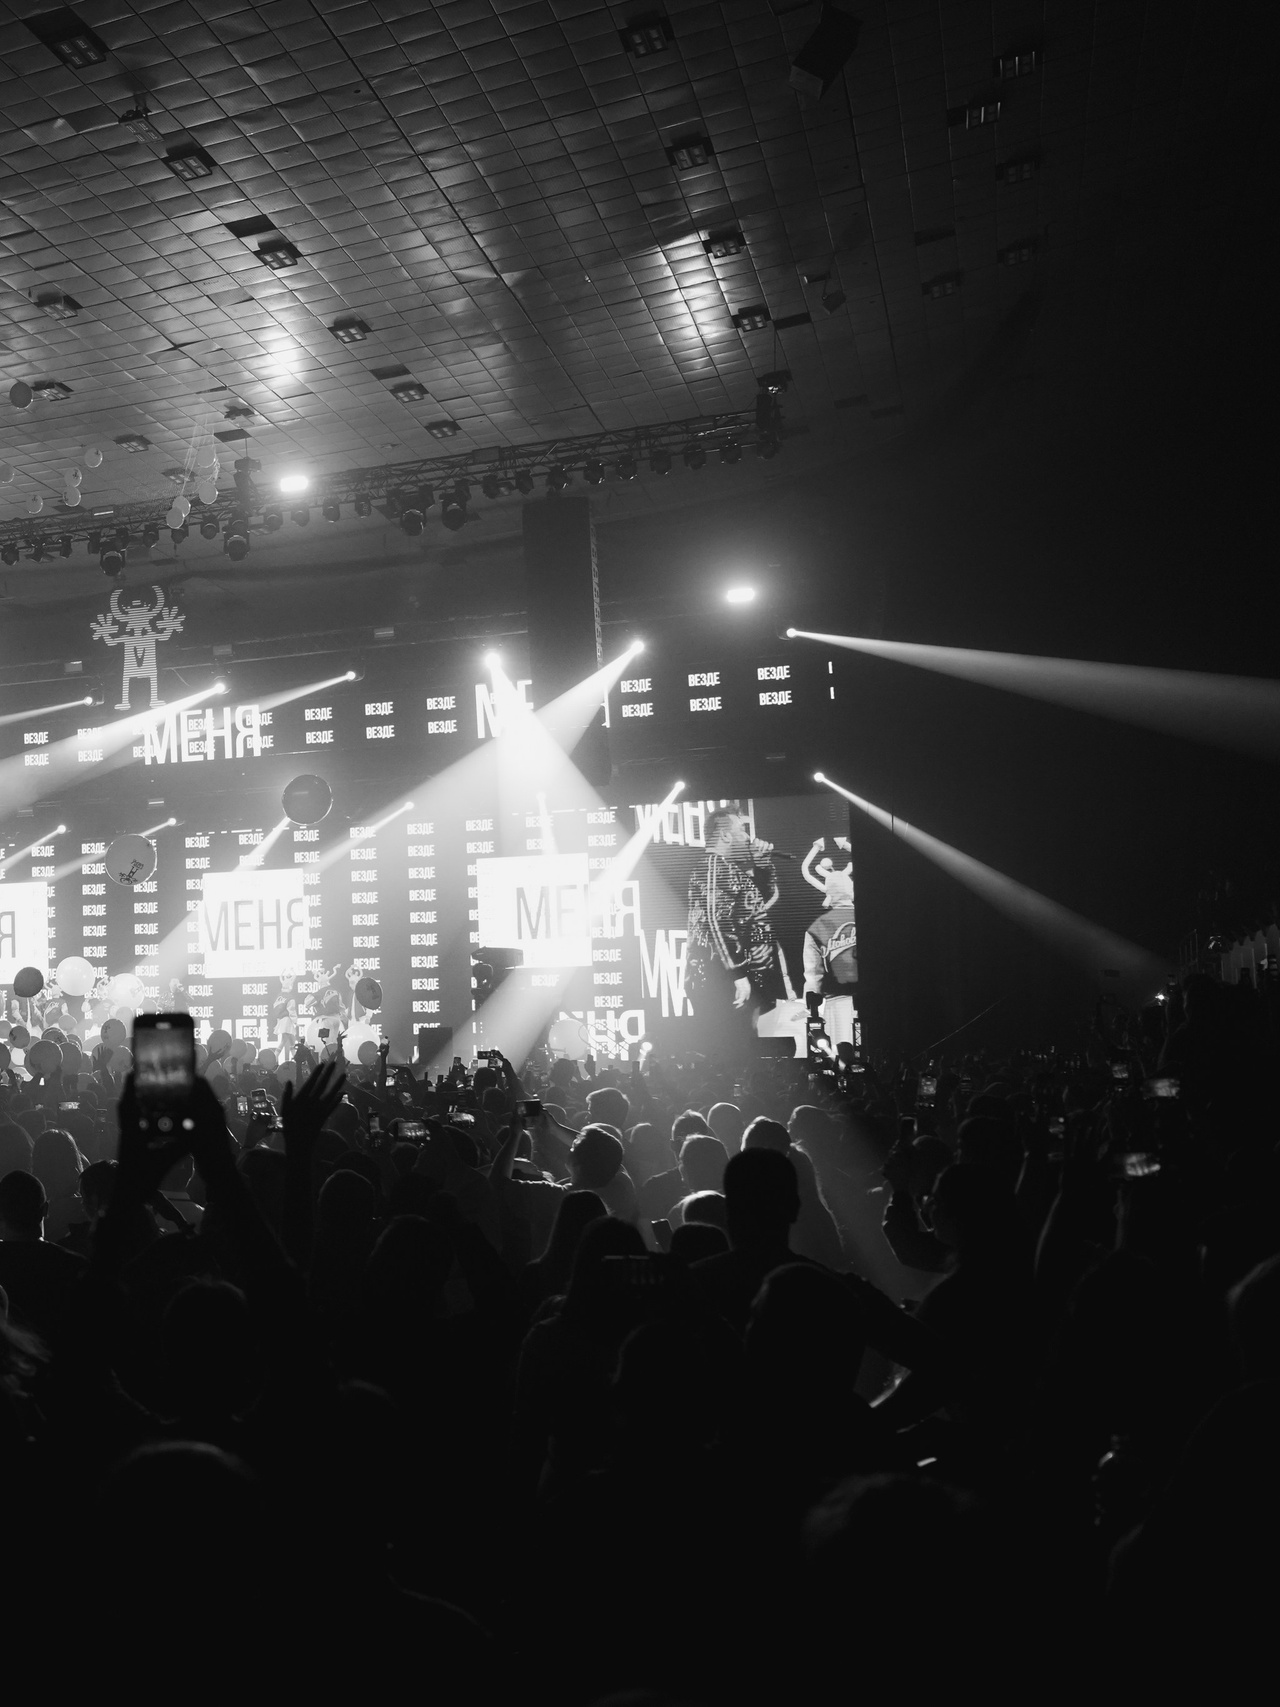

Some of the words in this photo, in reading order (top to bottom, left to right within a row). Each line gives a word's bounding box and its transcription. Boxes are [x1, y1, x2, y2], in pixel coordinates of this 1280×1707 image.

[757, 665, 790, 680] ВЕЗДЕ
[688, 672, 720, 686] ВЕЗДЕ
[621, 678, 652, 693] ВЕЗДЕ
[426, 696, 456, 710] ВЕЗДЕ
[759, 690, 792, 705] ВЕЗДЕ
[365, 702, 394, 716] ВЕЗДЕ
[622, 703, 654, 717] ВЕЗДЕ
[690, 697, 722, 711] ВЕЗДЕ
[304, 707, 333, 721] ВЕЗДЕ
[366, 725, 395, 739] ВЕЗДЕ
[428, 720, 457, 734] ВЕЗДЕ
[24, 731, 49, 744] ВЕЗДЕ
[77, 727, 103, 740] ВЕЗДЕ
[145, 705, 261, 765] МЕНЯ
[306, 730, 334, 744] ВЕЗДЕ
[25, 754, 49, 766] ВЕЗДЕ
[78, 749, 104, 762] ВЕЗДЕ
[587, 811, 616, 824] ВЕЗДЕ
[407, 823, 434, 835] ВЕЗДЕ
[465, 819, 494, 831] ВЕЗДЕ
[239, 833, 264, 845] ВЕЗДЕ
[293, 830, 320, 842] ВЕЗДЕ
[350, 827, 376, 839] ВЕЗДЕ
[185, 836, 210, 848] ВЕЗДЕ
[588, 834, 617, 847] ВЕЗДЕ
[32, 846, 55, 857] ВЕЗДЕ
[82, 842, 106, 854] ВЕЗДЕ
[408, 845, 435, 857] ВЕЗДЕ
[466, 841, 494, 853] ВЕЗДЕ
[294, 852, 320, 864] ВЕЗДЕ
[351, 848, 377, 860] ВЕЗДЕ
[186, 857, 210, 869] ВЕЗДЕ
[239, 855, 265, 867] ВЕЗДЕ
[32, 866, 55, 877] ВЕЗДЕ
[82, 863, 106, 875] ВЕЗДЕ
[409, 867, 436, 879] ВЕЗДЕ
[351, 870, 377, 882] ВЕЗДЕ
[82, 883, 106, 895] ВЕЗДЕ
[134, 881, 158, 893] ВЕЗДЕ
[352, 892, 378, 904] ВЕЗДЕ
[409, 889, 436, 901] ВЕЗДЕ
[83, 904, 107, 916] ВЕЗДЕ
[134, 902, 158, 914] ВЕЗДЕ
[352, 914, 379, 925] ВЕЗДЕ
[410, 911, 437, 923] ВЕЗДЕ
[83, 925, 107, 937] ВЕЗДЕ
[134, 923, 159, 935] ВЕЗДЕ
[353, 936, 379, 948] ВЕЗДЕ
[411, 934, 438, 946] ВЕЗДЕ
[83, 946, 107, 958] ВЕЗДЕ
[135, 944, 159, 956] ВЕЗДЕ
[592, 949, 622, 962] ВЕЗДЕ
[354, 958, 380, 970] ВЕЗДЕ
[411, 956, 439, 968] ВЕЗДЕ
[135, 965, 159, 977] ВЕЗДЕ
[412, 978, 439, 990] ВЕЗДЕ
[593, 972, 622, 985] ВЕЗДЕ
[189, 985, 213, 997] ВЕЗДЕ
[242, 983, 268, 995] ВЕЗДЕ
[413, 1001, 440, 1013] ВЕЗДЕ
[594, 995, 624, 1008] ВЕЗДЕ
[189, 1006, 214, 1018] ВЕЗДЕ
[243, 1005, 268, 1017] ВЕЗДЕ
